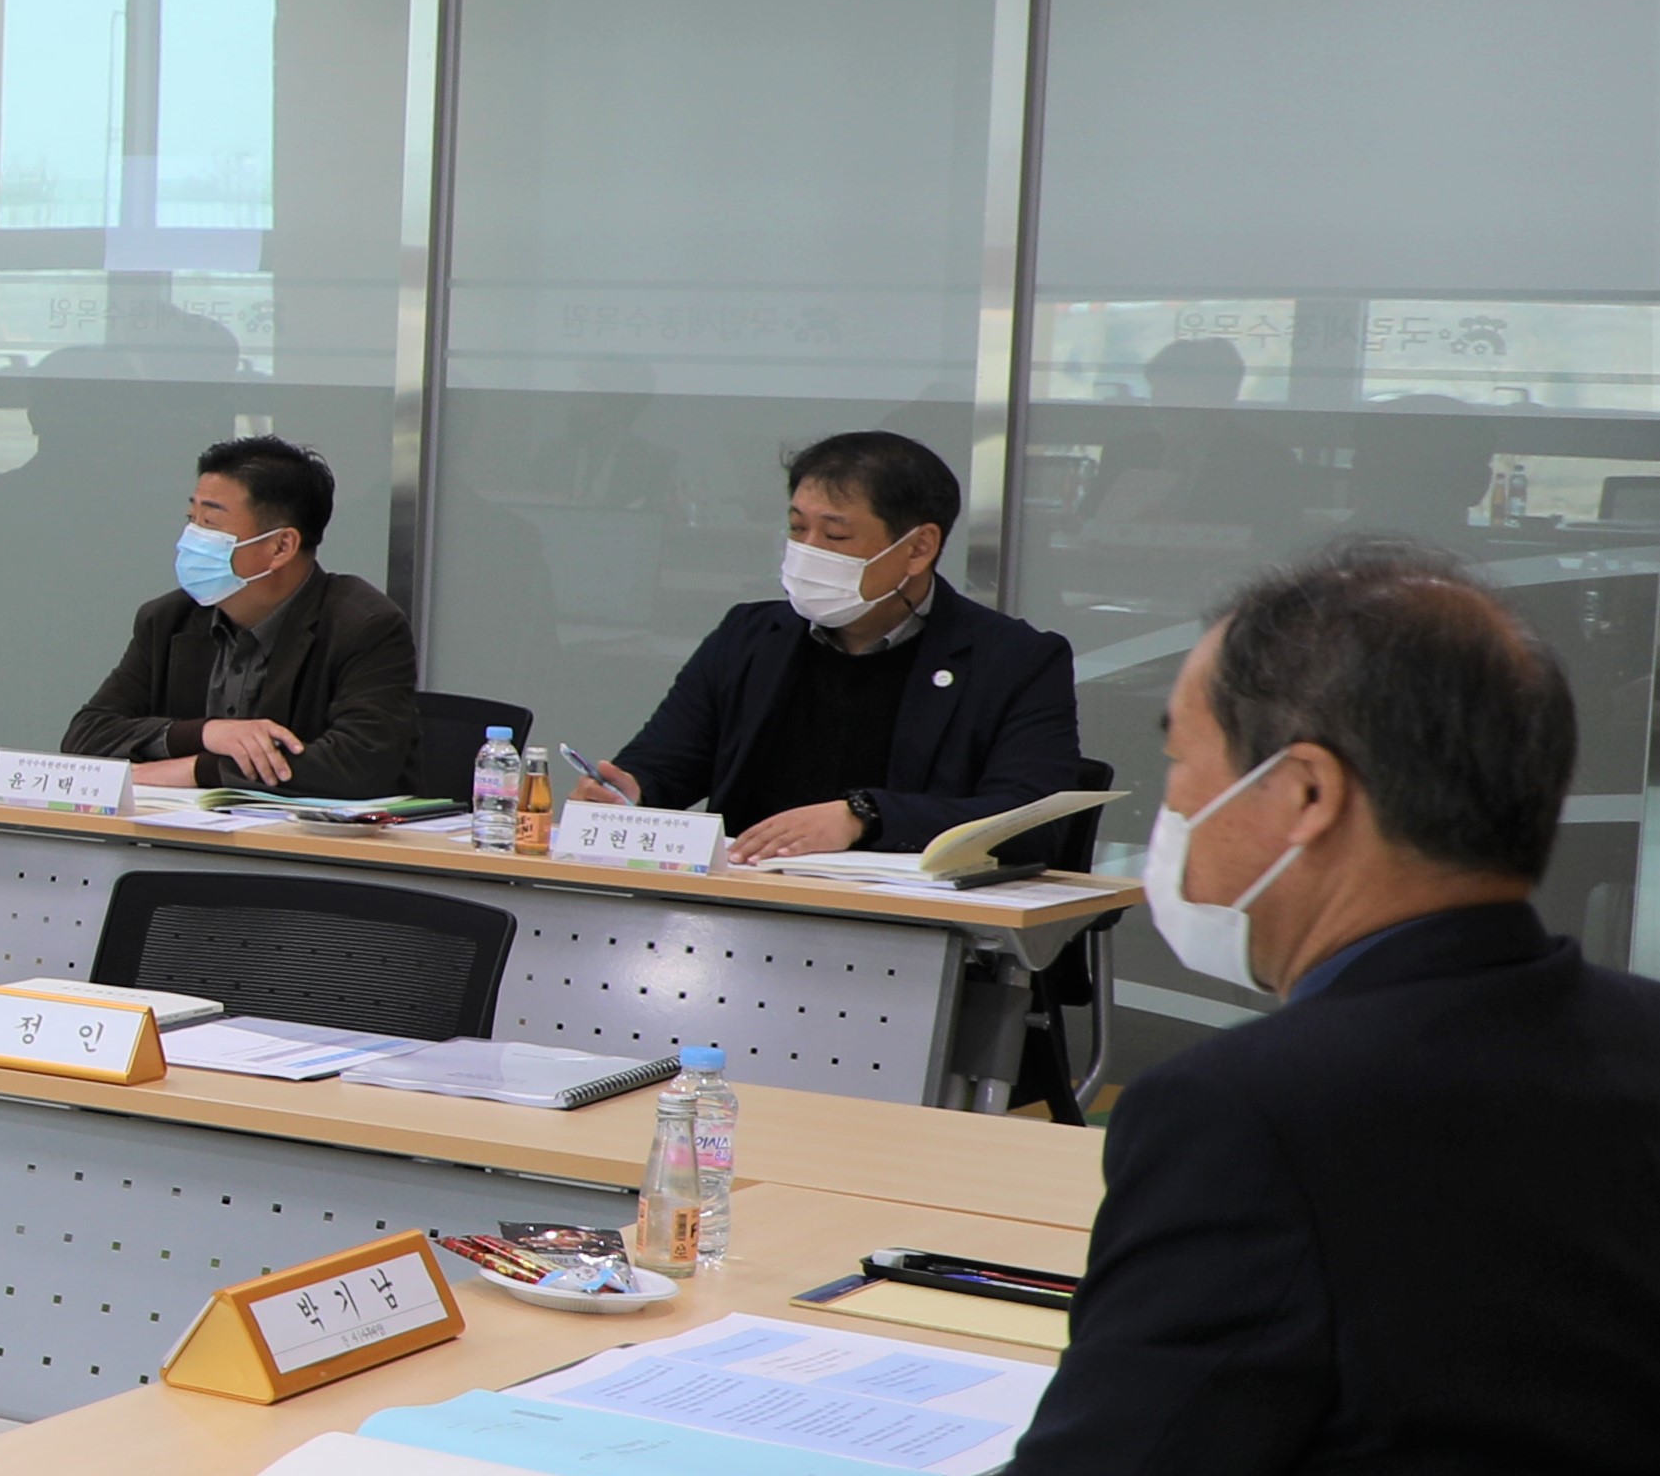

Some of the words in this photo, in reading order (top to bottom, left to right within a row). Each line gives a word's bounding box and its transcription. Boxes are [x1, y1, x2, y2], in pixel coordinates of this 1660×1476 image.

[8, 771, 74, 796] 윤기택
[580, 826, 657, 853] 김현철
[295, 1267, 399, 1333] 박기남
